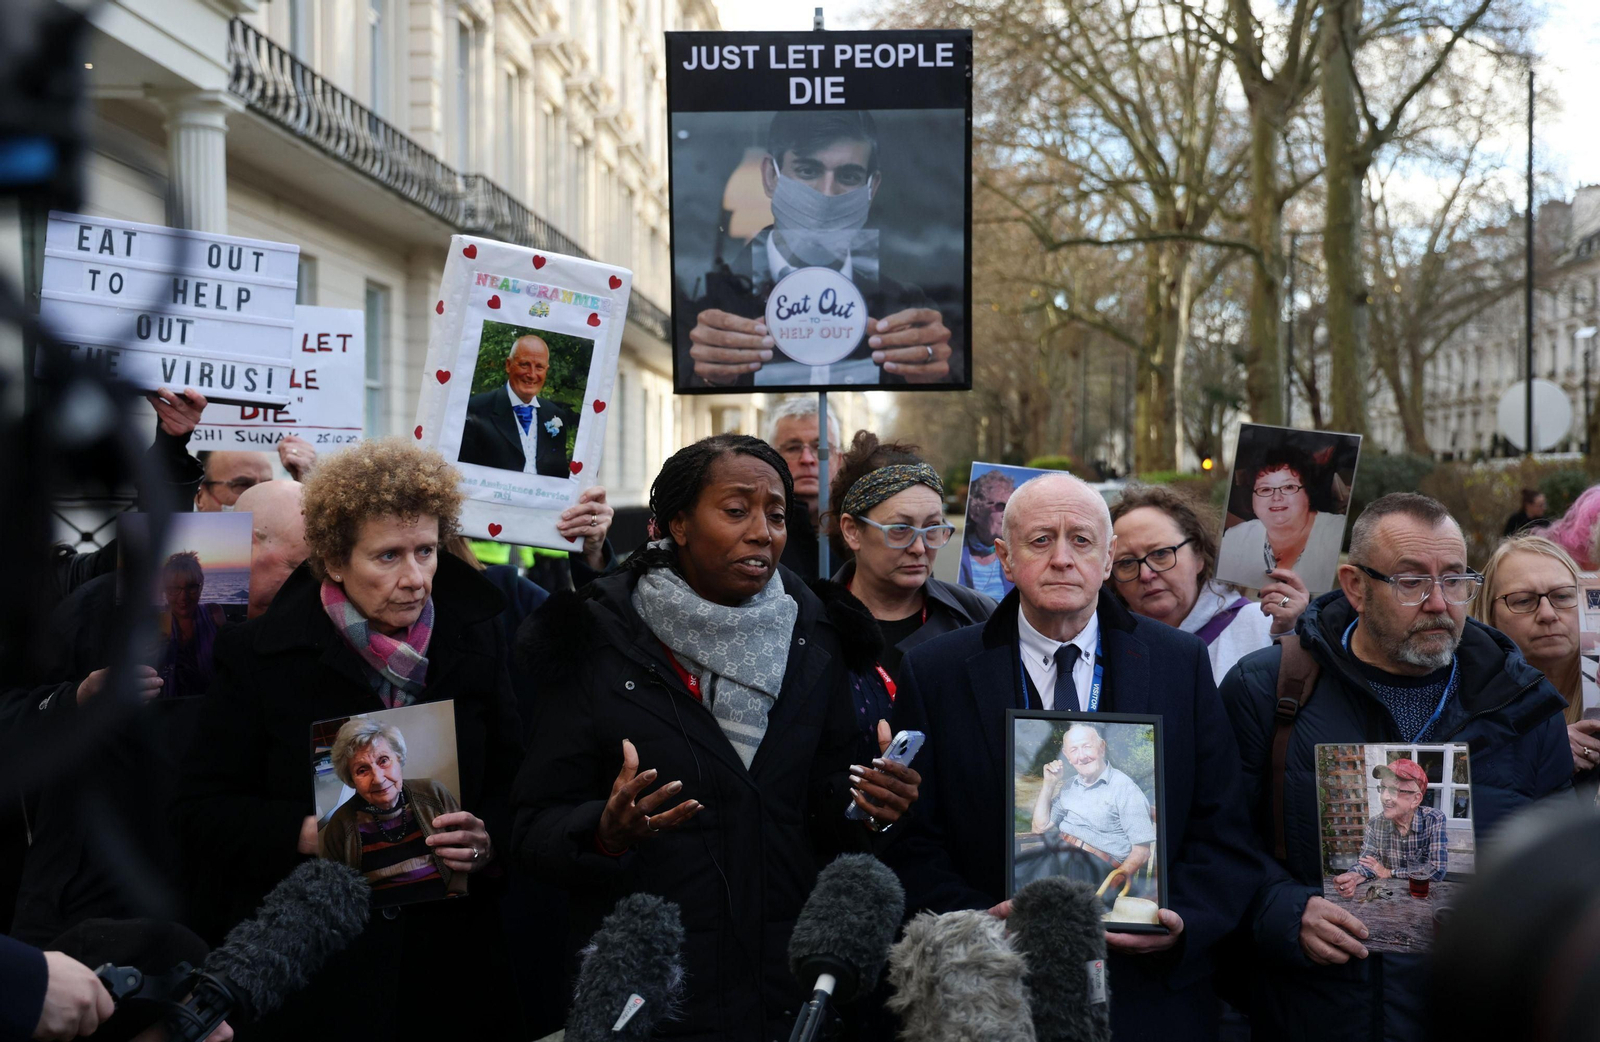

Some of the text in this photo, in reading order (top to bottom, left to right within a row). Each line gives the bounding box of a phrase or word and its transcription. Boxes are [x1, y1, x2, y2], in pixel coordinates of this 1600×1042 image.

[682, 43, 954, 70] JUST LET PEOPLE
[789, 76, 846, 105] DIE
[77, 224, 264, 273] EAT OUT
[88, 268, 251, 312] TO HELP
[475, 272, 612, 313] NEAL CRANMER
[776, 287, 856, 321] Eat Out
[136, 313, 194, 345] OUT
[302, 332, 353, 353] LET
[779, 326, 853, 340] HELP OUT
[161, 357, 274, 395] VIRUS!
[479, 479, 534, 496] Ambulance
[535, 488, 570, 502] Service
[1091, 683, 1100, 710] VISITOR
